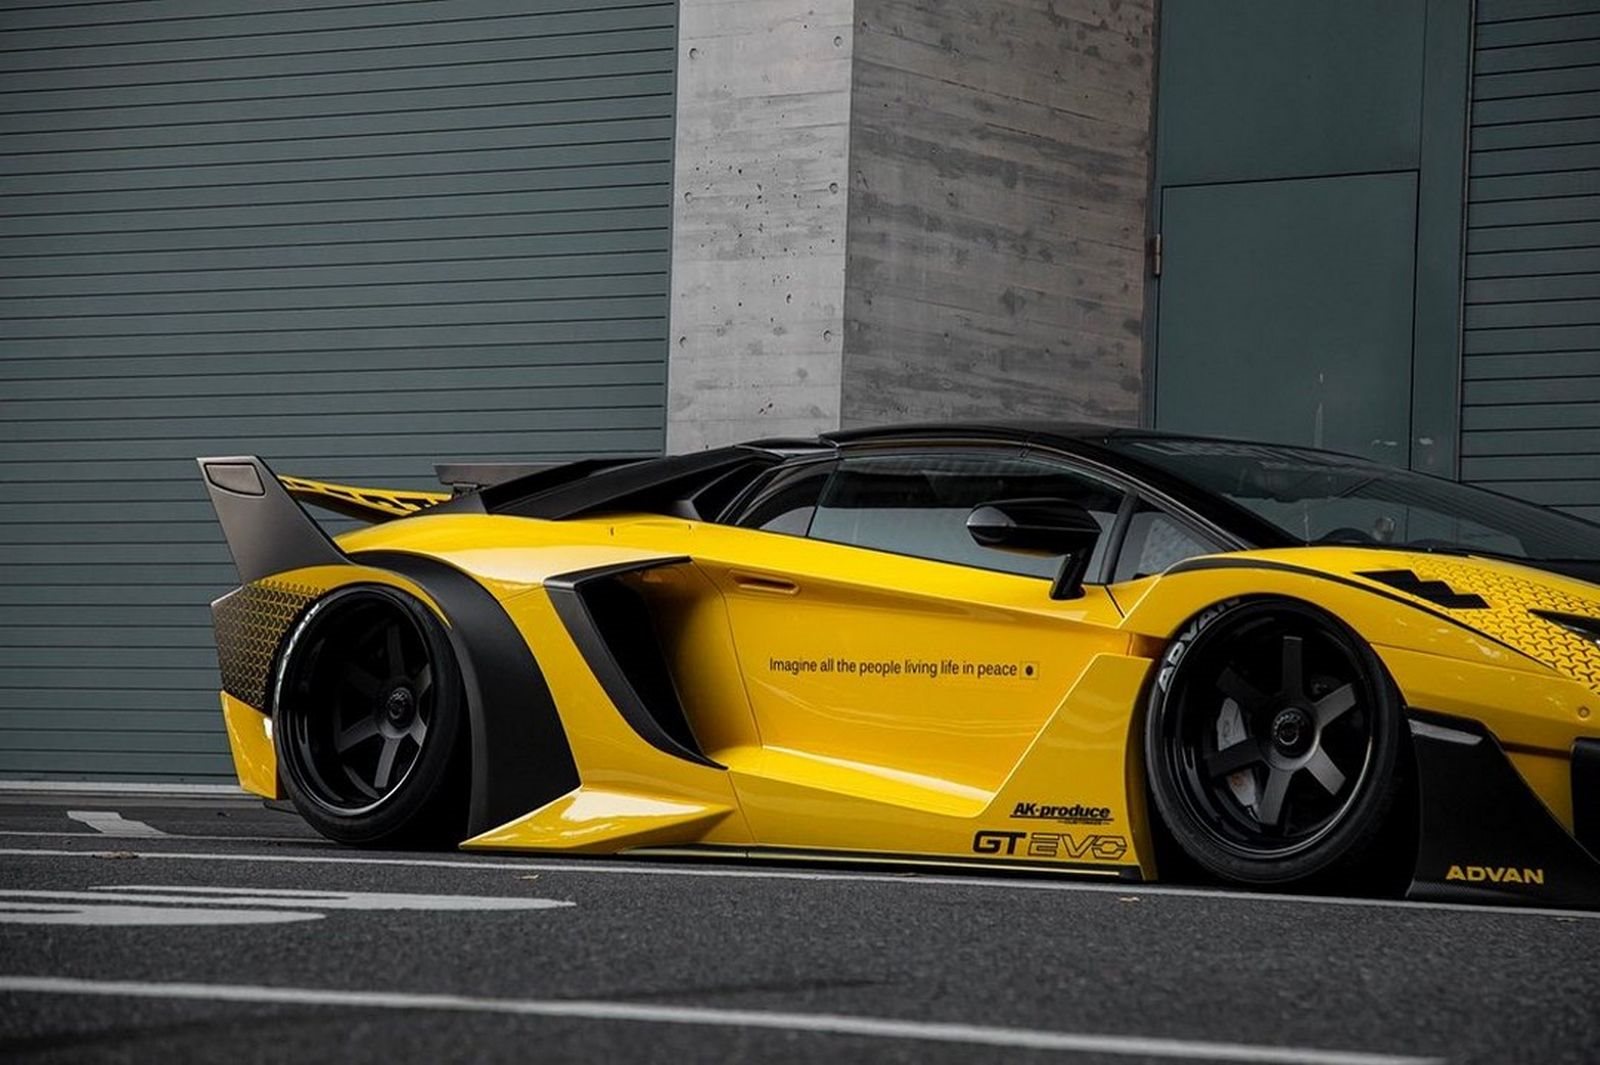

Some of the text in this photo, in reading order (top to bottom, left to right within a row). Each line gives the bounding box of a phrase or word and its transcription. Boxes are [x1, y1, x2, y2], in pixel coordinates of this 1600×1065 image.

[769, 657, 1017, 678] Imagine all the people living life in peace
[1445, 865, 1544, 884] ADVAN
